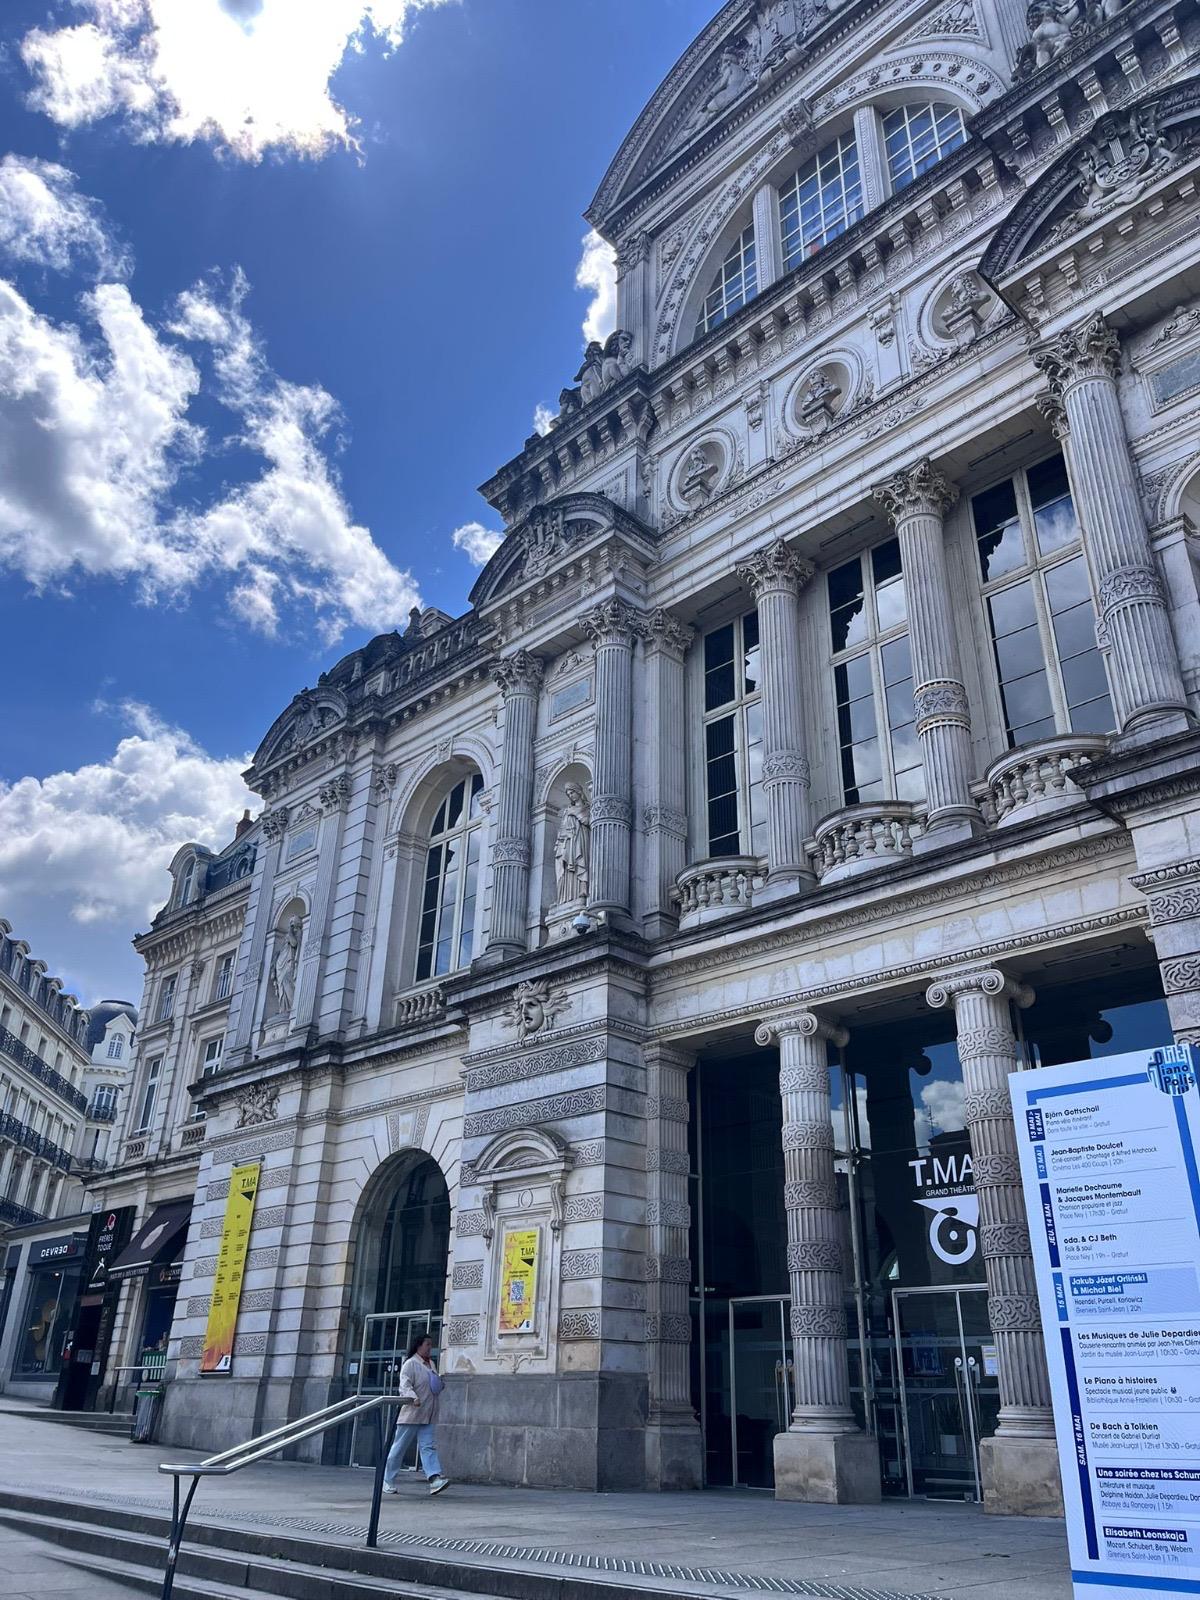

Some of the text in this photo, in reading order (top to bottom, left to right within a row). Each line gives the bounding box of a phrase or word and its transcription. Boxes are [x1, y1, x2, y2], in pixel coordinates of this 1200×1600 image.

[1051, 1141, 1123, 1156] Jean-Baptiste Doulcet
[926, 1185, 976, 1196] GRAND THÉÂTR
[1056, 1182, 1122, 1194] Marielle Dechaume
[1064, 1194, 1094, 1203] Jacques
[1094, 1189, 1141, 1200] Montembault
[1044, 1203, 1052, 1218] MAI
[1046, 1218, 1054, 1227] 14
[1091, 1332, 1127, 1341] Musiques
[1102, 1422, 1122, 1430] Bach
[1074, 1414, 1086, 1466] SAM. 16 MAI
[1115, 1469, 1138, 1478] soirée
[1140, 1469, 1159, 1478] chez
[1161, 1470, 1173, 1478] les
[1105, 1528, 1185, 1541] Elisabeth Leonskaja
